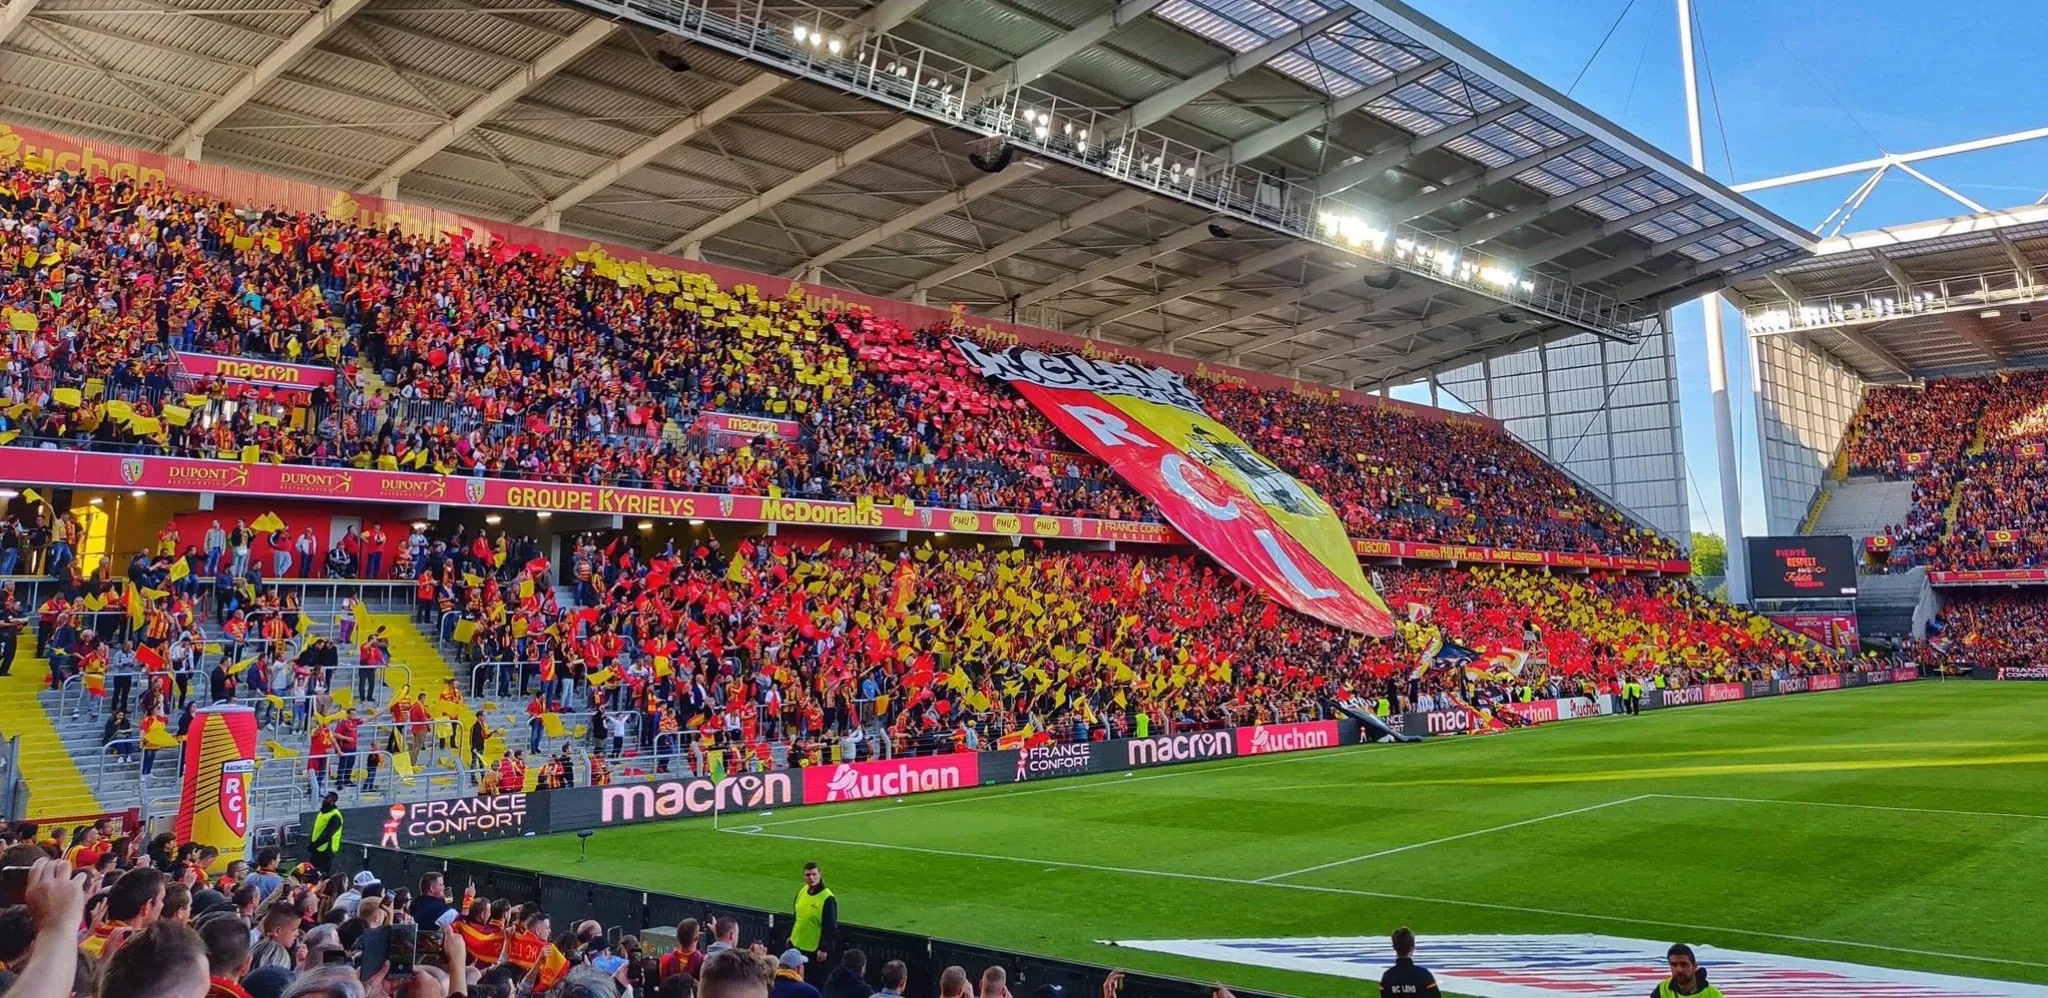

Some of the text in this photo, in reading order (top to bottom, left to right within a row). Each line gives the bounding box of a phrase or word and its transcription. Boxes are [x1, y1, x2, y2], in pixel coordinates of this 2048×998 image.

[216, 360, 299, 382] macron
[728, 417, 778, 432] macron
[169, 466, 229, 480] DUPONT
[281, 472, 335, 485] DUPONT
[381, 479, 430, 491] DUPONT
[508, 486, 695, 517] GROUPE KYRIELYS
[760, 500, 883, 526] McDonalds
[953, 515, 971, 527] PMU
[996, 518, 1012, 528] PMU
[1036, 520, 1051, 531] PMU
[1105, 523, 1138, 532] FRANCE
[1357, 541, 1390, 554] macron
[1663, 687, 1702, 706] macron
[1709, 685, 1740, 701] Auchan
[1251, 726, 1328, 753] Auchan
[1030, 743, 1090, 759] FRANCE
[1128, 731, 1232, 765] macron
[1029, 756, 1090, 771] CONFORT
[826, 763, 960, 801] Auchan
[226, 778, 245, 828] RCL
[602, 773, 791, 822] macron
[411, 793, 527, 820] FRANCE
[408, 811, 526, 836] CONFORT
[1391, 985, 1416, 993] RC LENS
